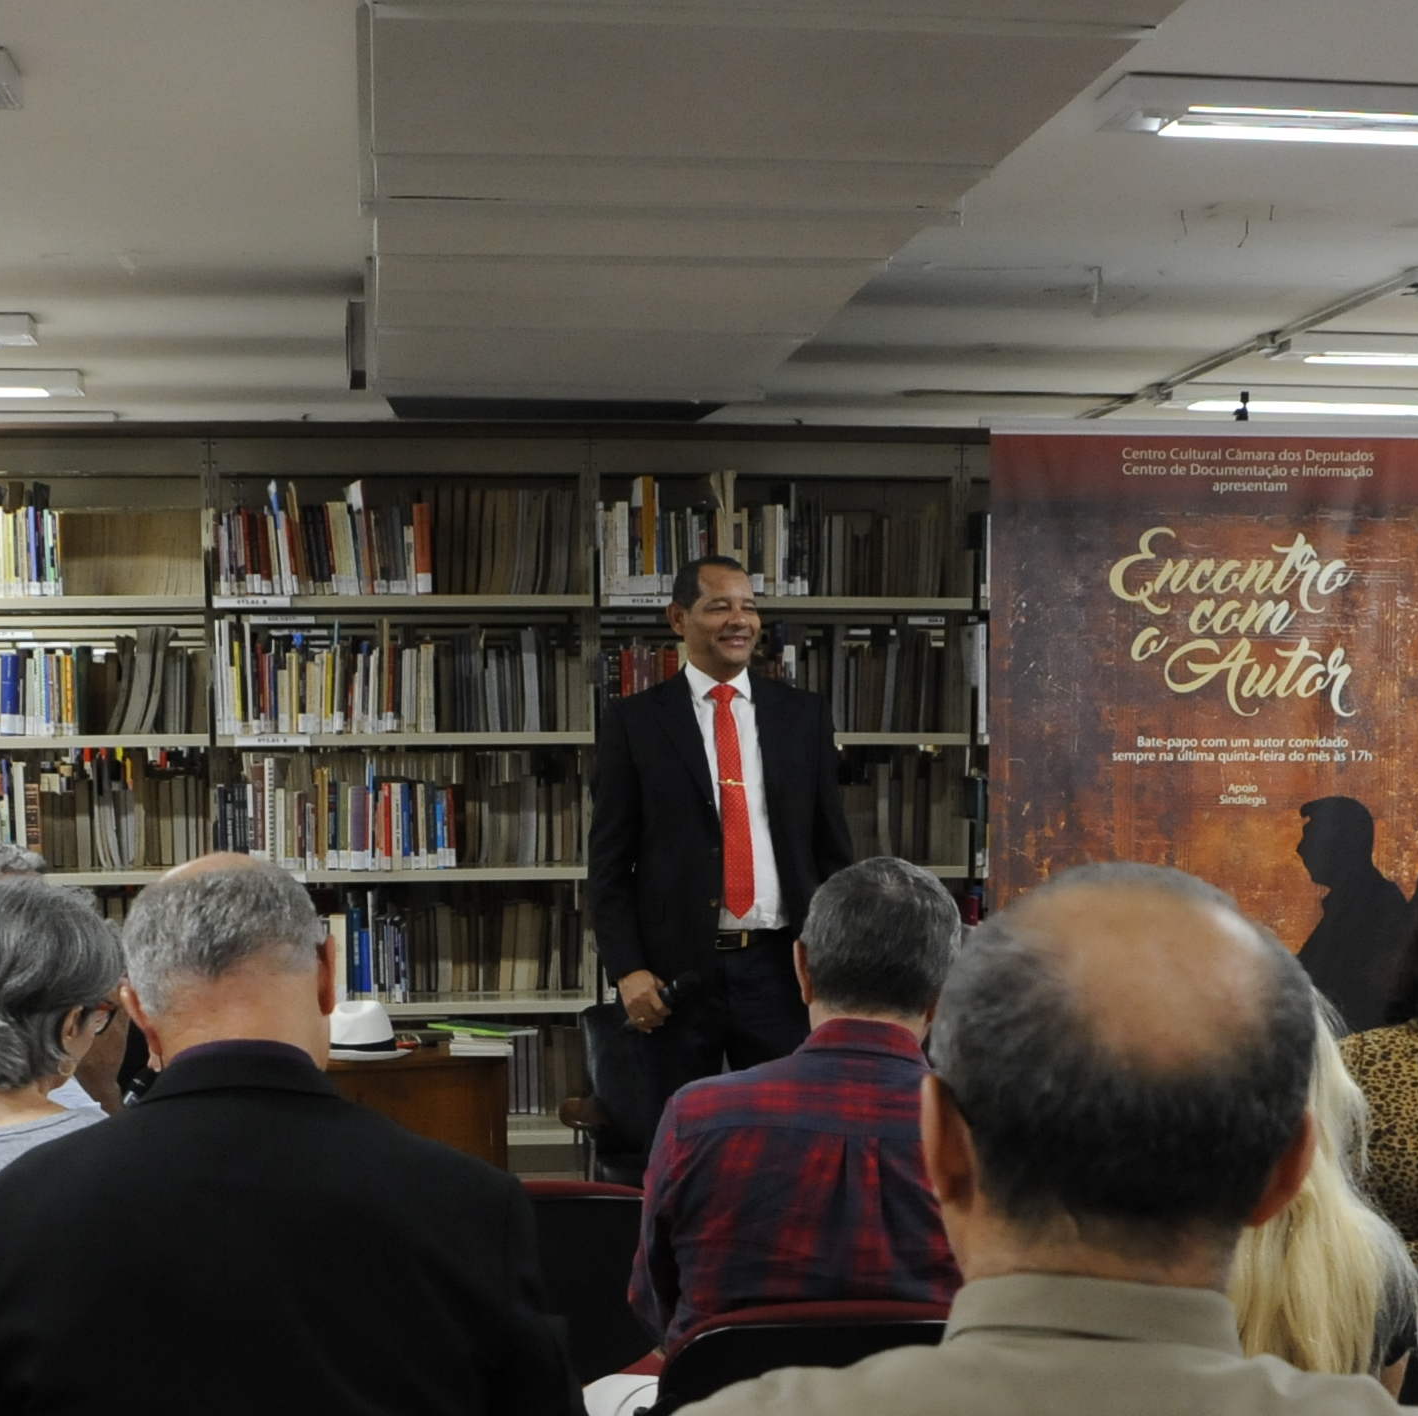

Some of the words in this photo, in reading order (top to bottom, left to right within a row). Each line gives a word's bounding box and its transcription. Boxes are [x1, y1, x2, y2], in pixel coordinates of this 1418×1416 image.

[1121, 447, 1166, 460] Centro
[1169, 447, 1222, 460] Cultural
[1225, 447, 1275, 461] Câmara
[1278, 448, 1302, 461] dos
[1305, 448, 1374, 465] Deputados
[1121, 462, 1167, 476] Centro
[1170, 463, 1187, 476] de
[1190, 463, 1288, 479] Documentação
[1290, 466, 1299, 477] e
[1302, 464, 1374, 480] Informação
[1212, 480, 1288, 495] apresentam
[1109, 526, 1354, 615] Encontro
[1188, 598, 1298, 635] com
[1131, 626, 1170, 662] o
[1164, 636, 1357, 717] Autor
[1136, 736, 1198, 752] Bate-papo
[1201, 737, 1227, 748] com
[1230, 737, 1250, 748] um
[1253, 736, 1285, 748] autor
[1288, 736, 1349, 748] convidado
[1111, 751, 1156, 764] sempre
[1158, 751, 1174, 762] na
[1177, 748, 1215, 762] última
[1218, 748, 1285, 764] quinta-feira
[1288, 749, 1305, 762] do
[1307, 748, 1331, 762] mês
[1333, 748, 1346, 762] às
[1350, 750, 1373, 762] 17h
[1227, 783, 1258, 795] Apoio
[1219, 794, 1267, 807] Sindilegis
